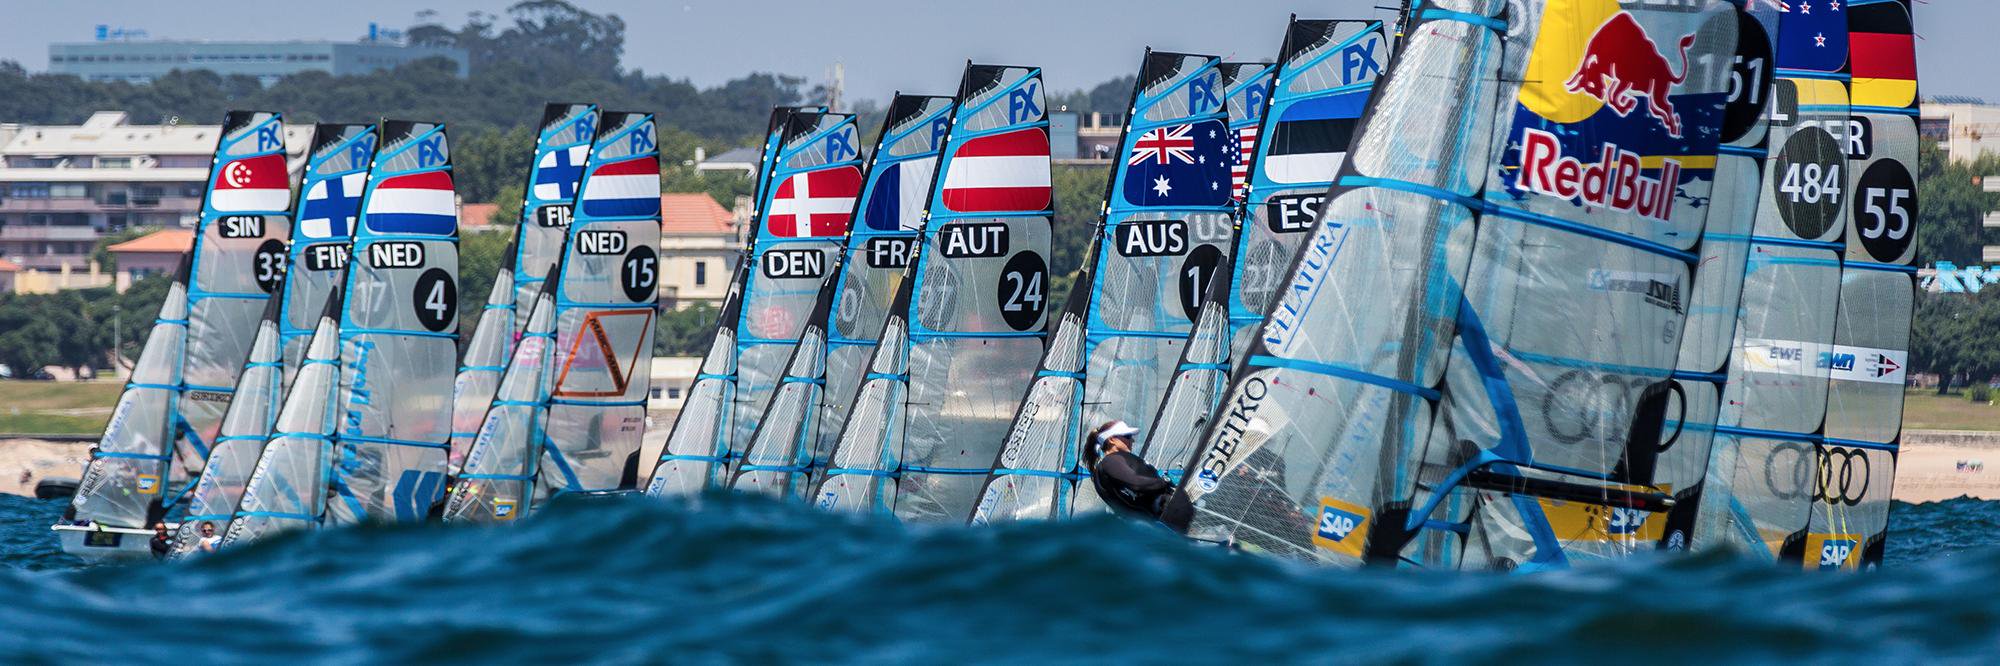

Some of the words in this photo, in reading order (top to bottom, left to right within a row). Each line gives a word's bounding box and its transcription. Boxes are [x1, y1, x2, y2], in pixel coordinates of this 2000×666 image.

[1341, 37, 1386, 86] FX
[1188, 72, 1221, 116] FX
[1697, 53, 1764, 104] 151
[1008, 83, 1042, 125] FX
[257, 123, 282, 152] FX
[418, 135, 445, 168] FX
[630, 125, 653, 155] FX
[825, 127, 856, 163] FX
[1517, 127, 1616, 206] Red
[1611, 149, 1682, 222] Bull
[1780, 162, 1841, 204] 484
[227, 216, 260, 238] SIN
[1195, 213, 1232, 240] US
[1280, 197, 1326, 229] ES
[1862, 187, 1911, 240] 55
[580, 231, 625, 254] NED
[946, 226, 1005, 256] AUT
[1125, 222, 1184, 254] AUS
[372, 243, 423, 267] NED
[767, 252, 821, 276] DEN
[627, 257, 655, 287] 15
[1187, 265, 1200, 308] 1
[1265, 220, 1344, 346] VELATURA
[424, 279, 448, 321] 4
[1004, 270, 1043, 312] 24
[1205, 376, 1268, 475] SEIKO
[1320, 511, 1354, 536] SAP
[1821, 545, 1849, 567] SAP
